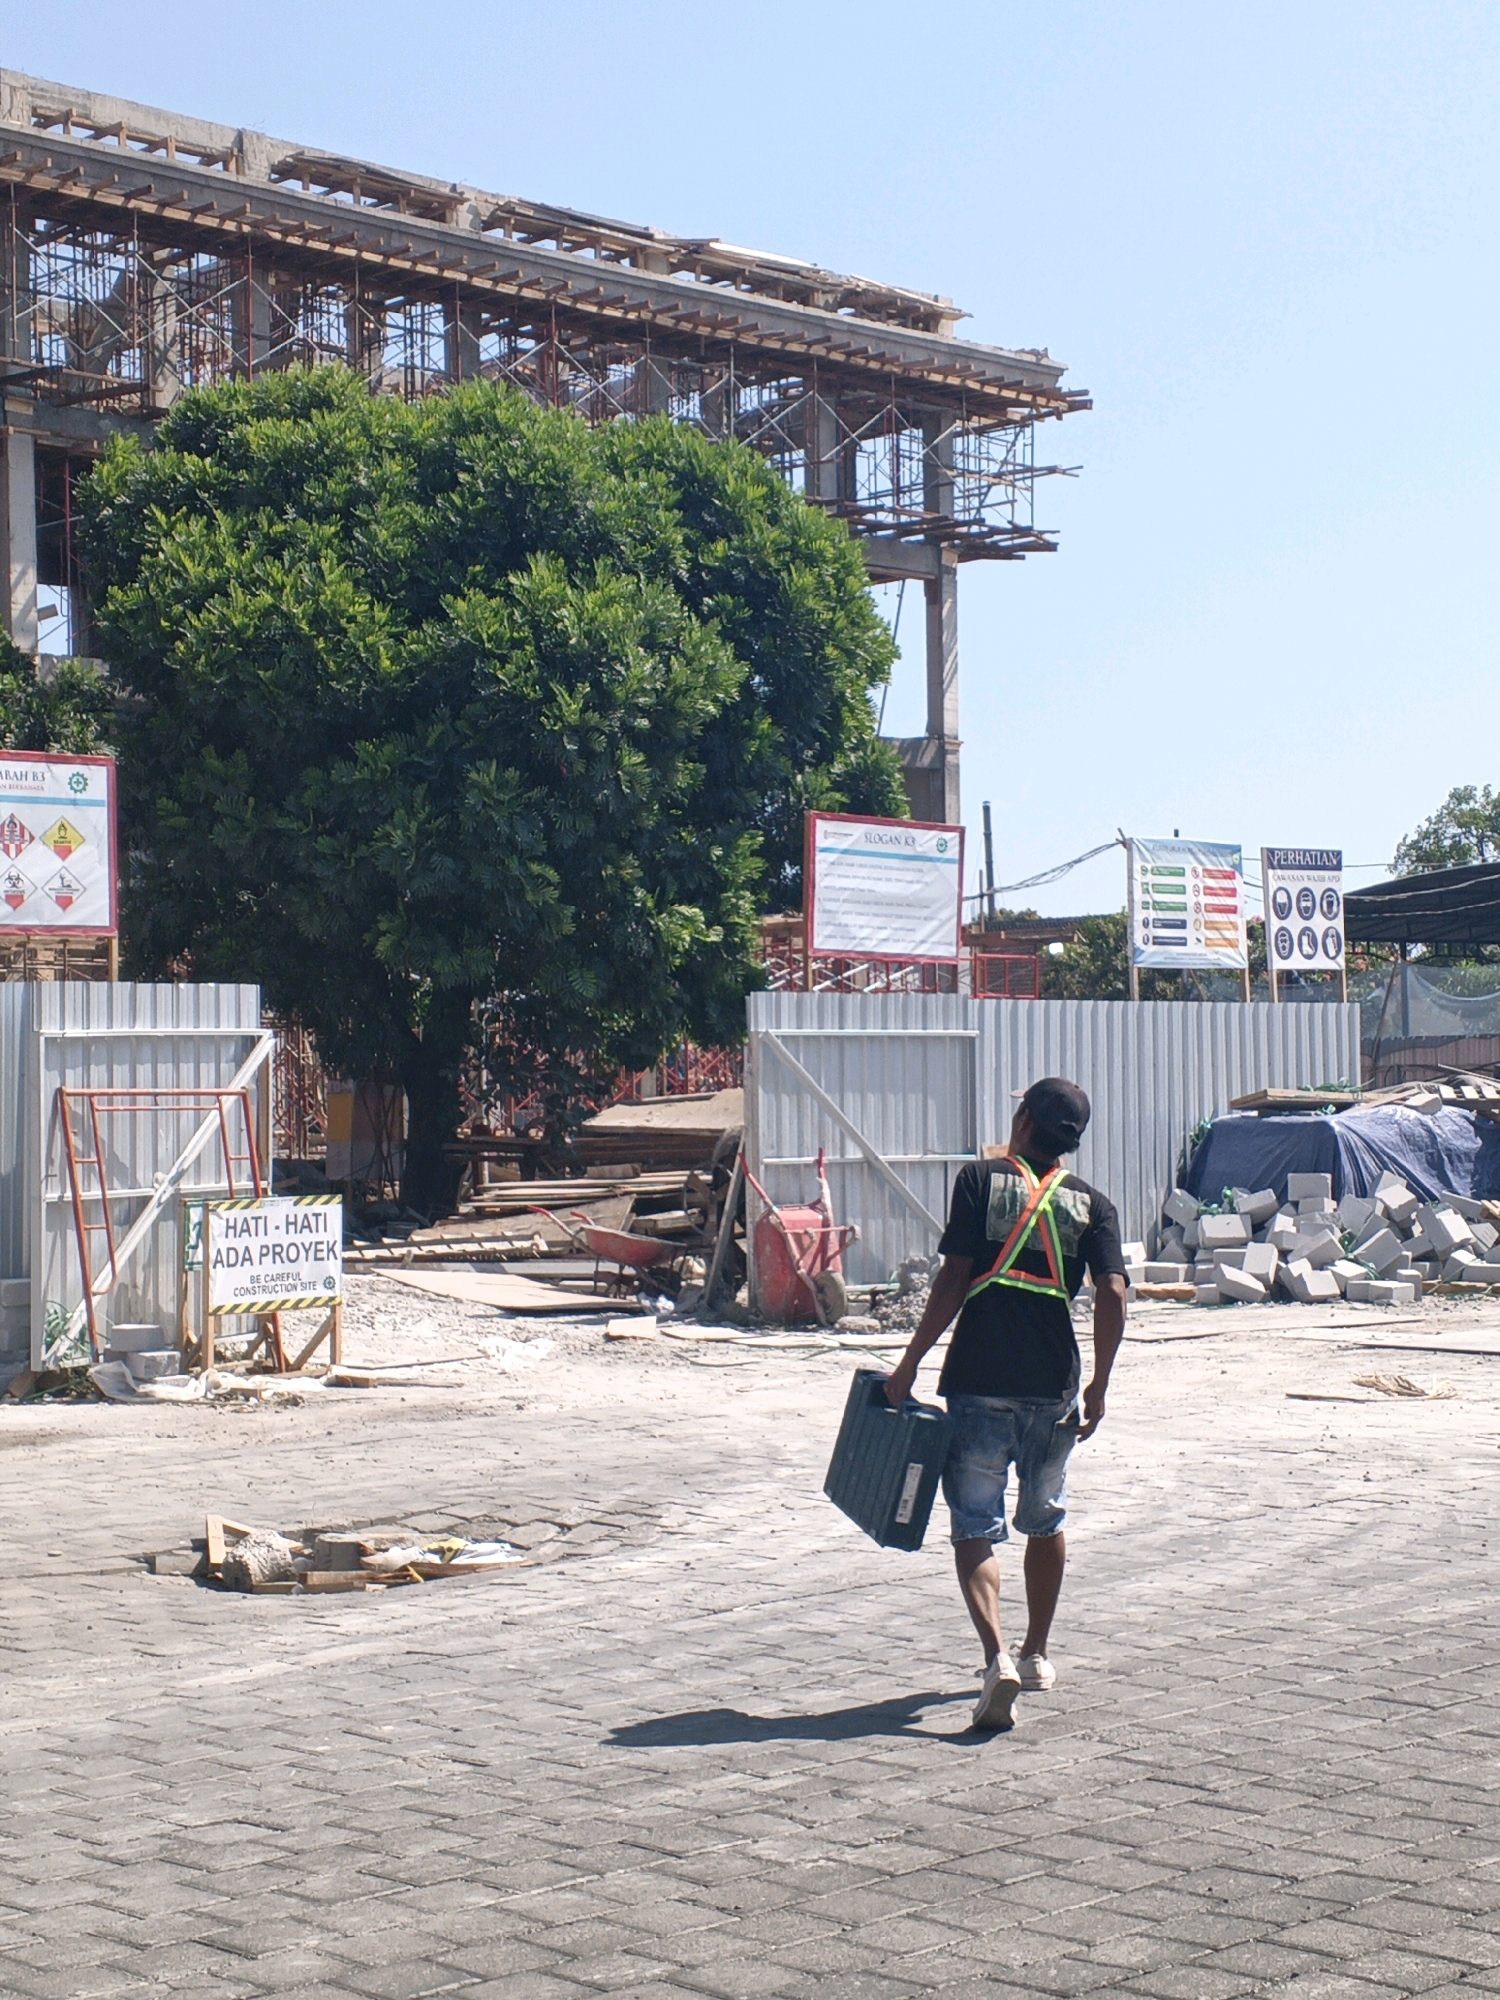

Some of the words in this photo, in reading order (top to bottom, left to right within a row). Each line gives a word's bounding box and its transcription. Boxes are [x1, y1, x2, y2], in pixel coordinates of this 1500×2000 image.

[32, 771, 45, 782] B3
[864, 831, 901, 846] SLOGAN
[903, 834, 917, 847] K3
[1274, 850, 1338, 866] PERHATIAN
[224, 1215, 268, 1239] HATI
[285, 1212, 328, 1235] HATI
[212, 1245, 254, 1269] ADA
[258, 1239, 339, 1266] PROYEK
[249, 1275, 262, 1285] BE
[263, 1271, 303, 1283] CAREFUL
[233, 1283, 298, 1298] CONSTRUCTION
[300, 1281, 318, 1292] SITE
